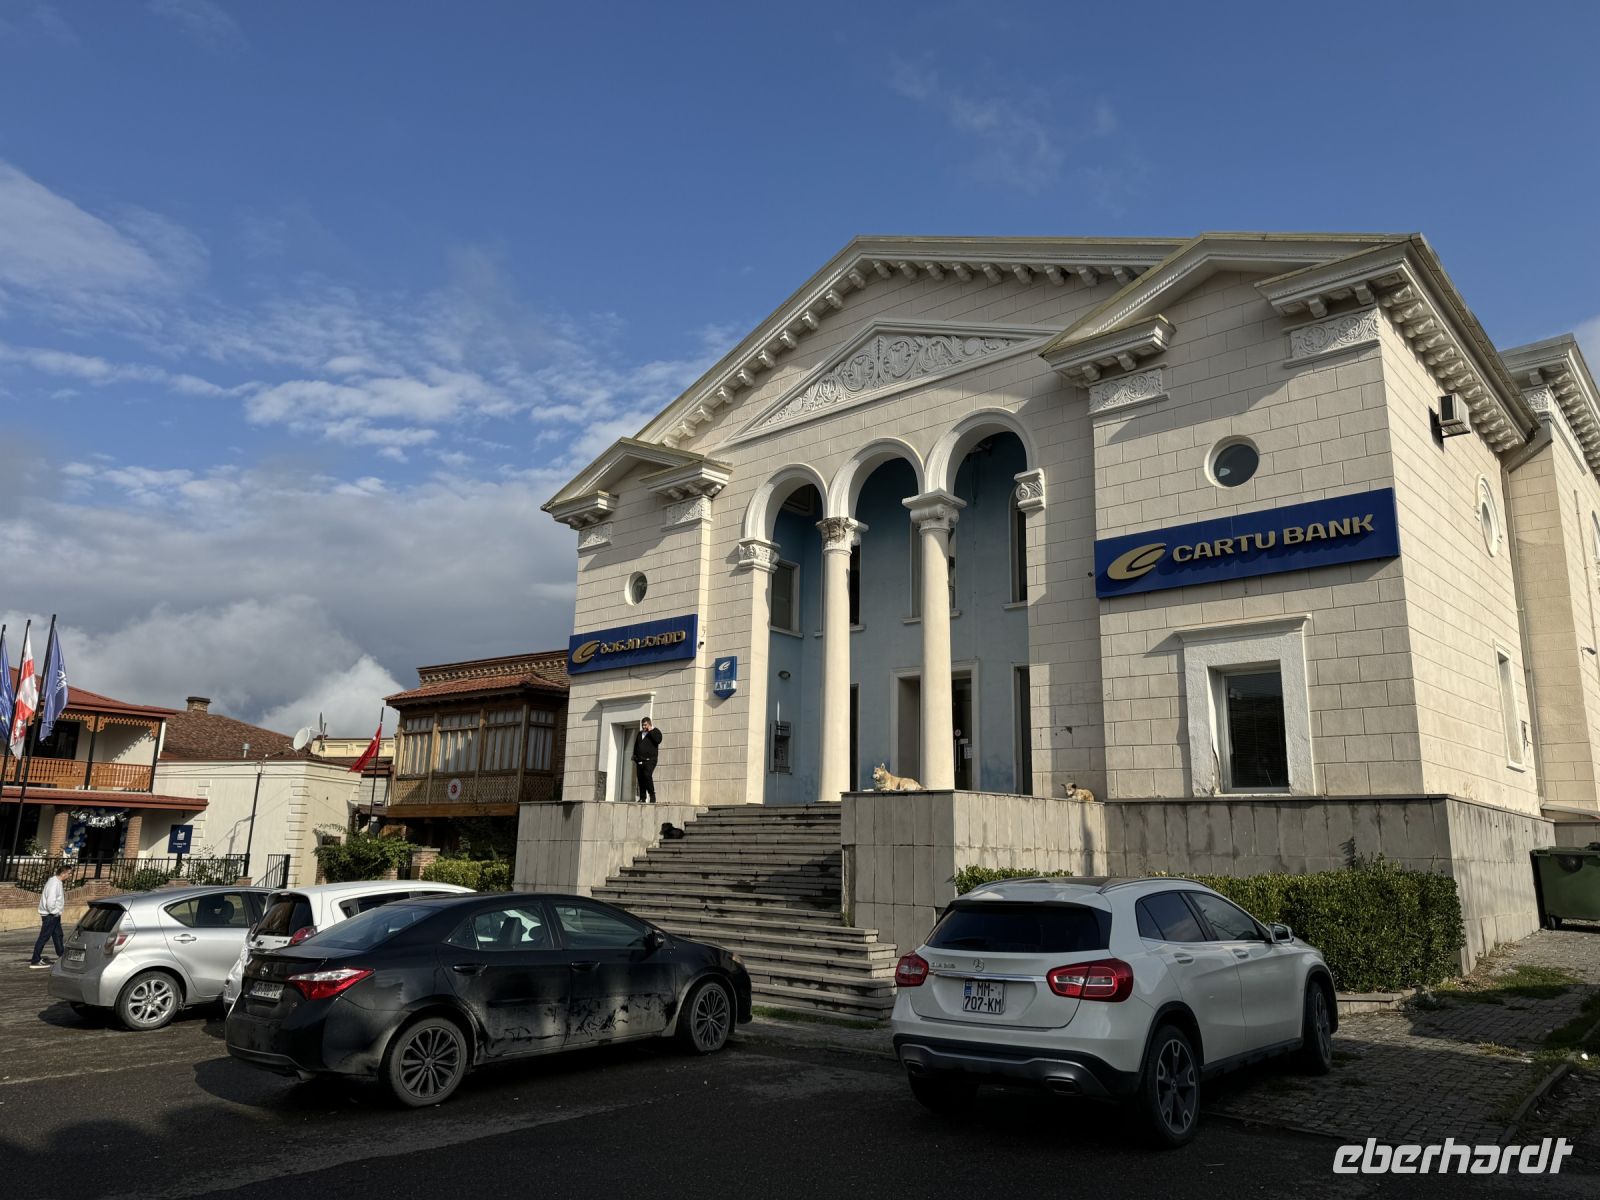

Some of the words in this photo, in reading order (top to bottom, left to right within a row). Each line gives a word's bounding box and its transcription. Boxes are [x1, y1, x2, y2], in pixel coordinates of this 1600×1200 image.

[1172, 530, 1276, 562] CARTU
[1283, 513, 1374, 545] BANK
[964, 996, 1002, 1013] 707-KM
